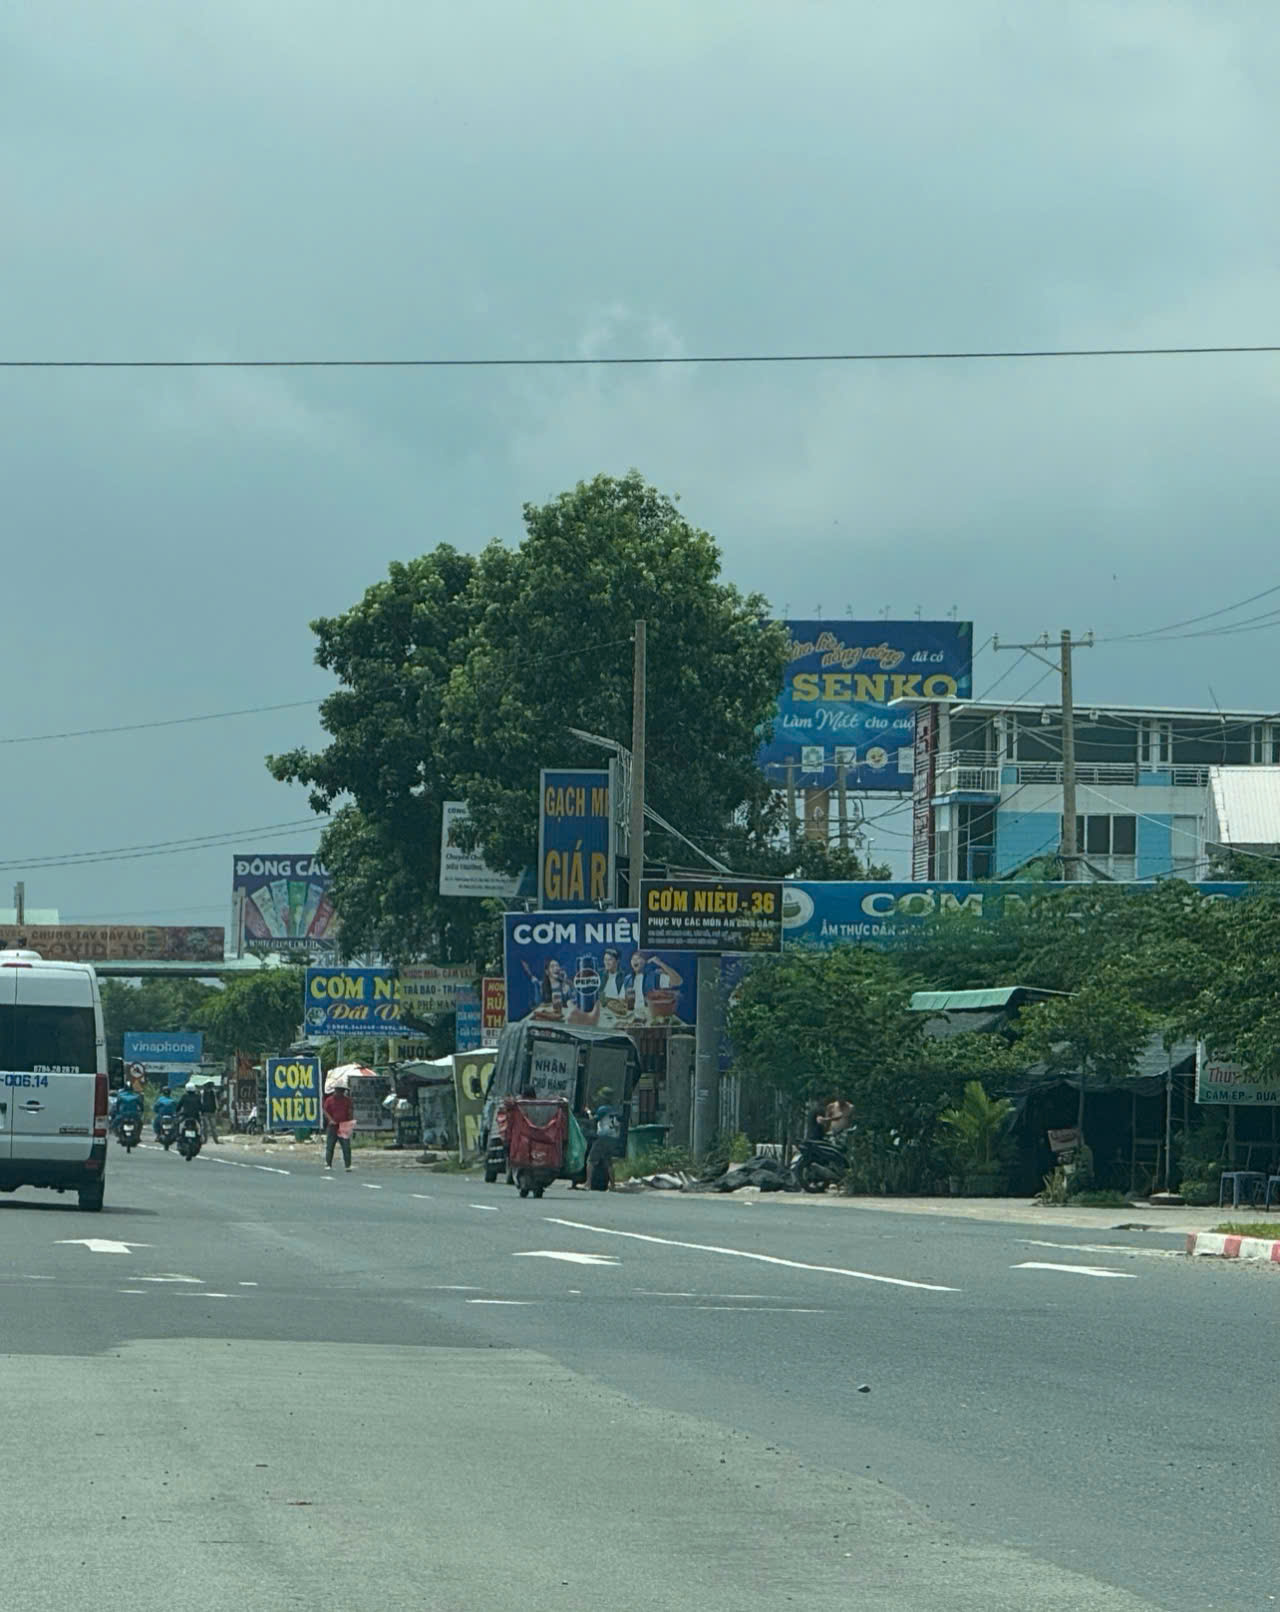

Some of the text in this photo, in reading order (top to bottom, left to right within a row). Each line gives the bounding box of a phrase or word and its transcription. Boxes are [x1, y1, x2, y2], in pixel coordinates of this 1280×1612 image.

[792, 673, 958, 702] SENKO
[783, 713, 813, 728] Làm
[864, 715, 889, 729] cho
[545, 786, 585, 823] GẠCH
[545, 839, 585, 901] GIÁ
[648, 886, 689, 911] CƠM
[751, 891, 775, 914] 36
[513, 921, 577, 945] CƠM
[310, 972, 365, 999] CƠM
[132, 1040, 195, 1053] vinaphone
[274, 1062, 314, 1089] CƠM
[272, 1091, 318, 1121] NIÊU
